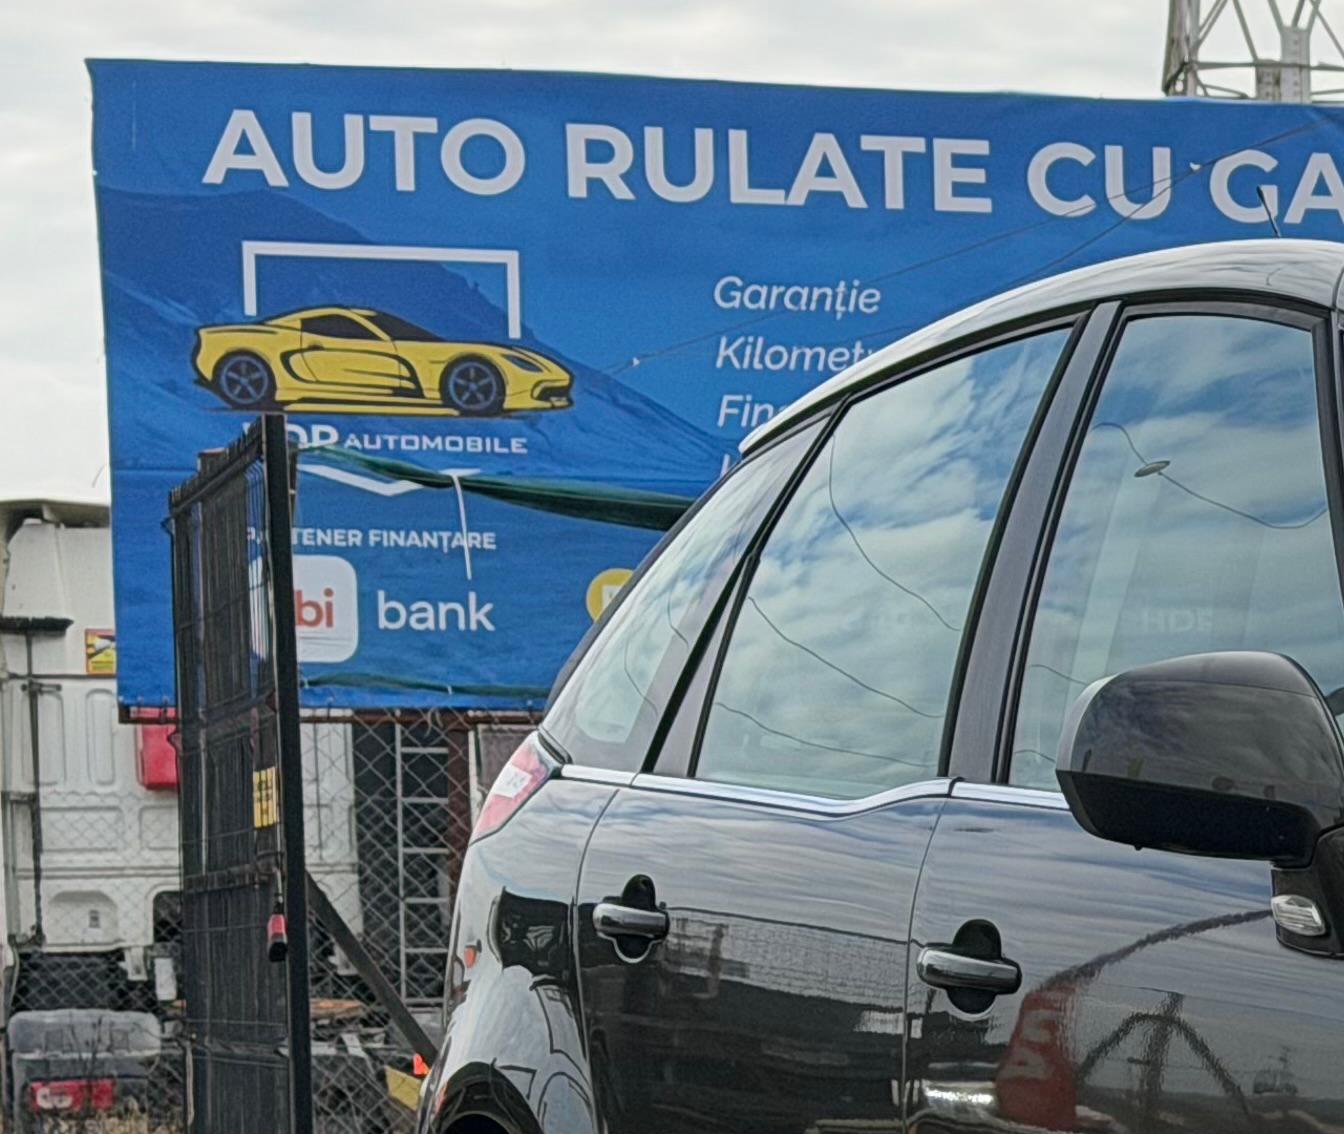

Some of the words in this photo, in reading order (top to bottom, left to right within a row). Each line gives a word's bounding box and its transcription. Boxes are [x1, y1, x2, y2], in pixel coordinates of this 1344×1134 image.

[201, 108, 525, 195] AUTO
[565, 122, 990, 214] RULATE
[1027, 142, 1171, 219] CU
[713, 276, 880, 319] Garanție
[715, 336, 876, 372] Kilomet
[717, 394, 784, 427] Fin
[345, 433, 528, 454] AUTOMOBILE
[377, 590, 495, 631] bank
